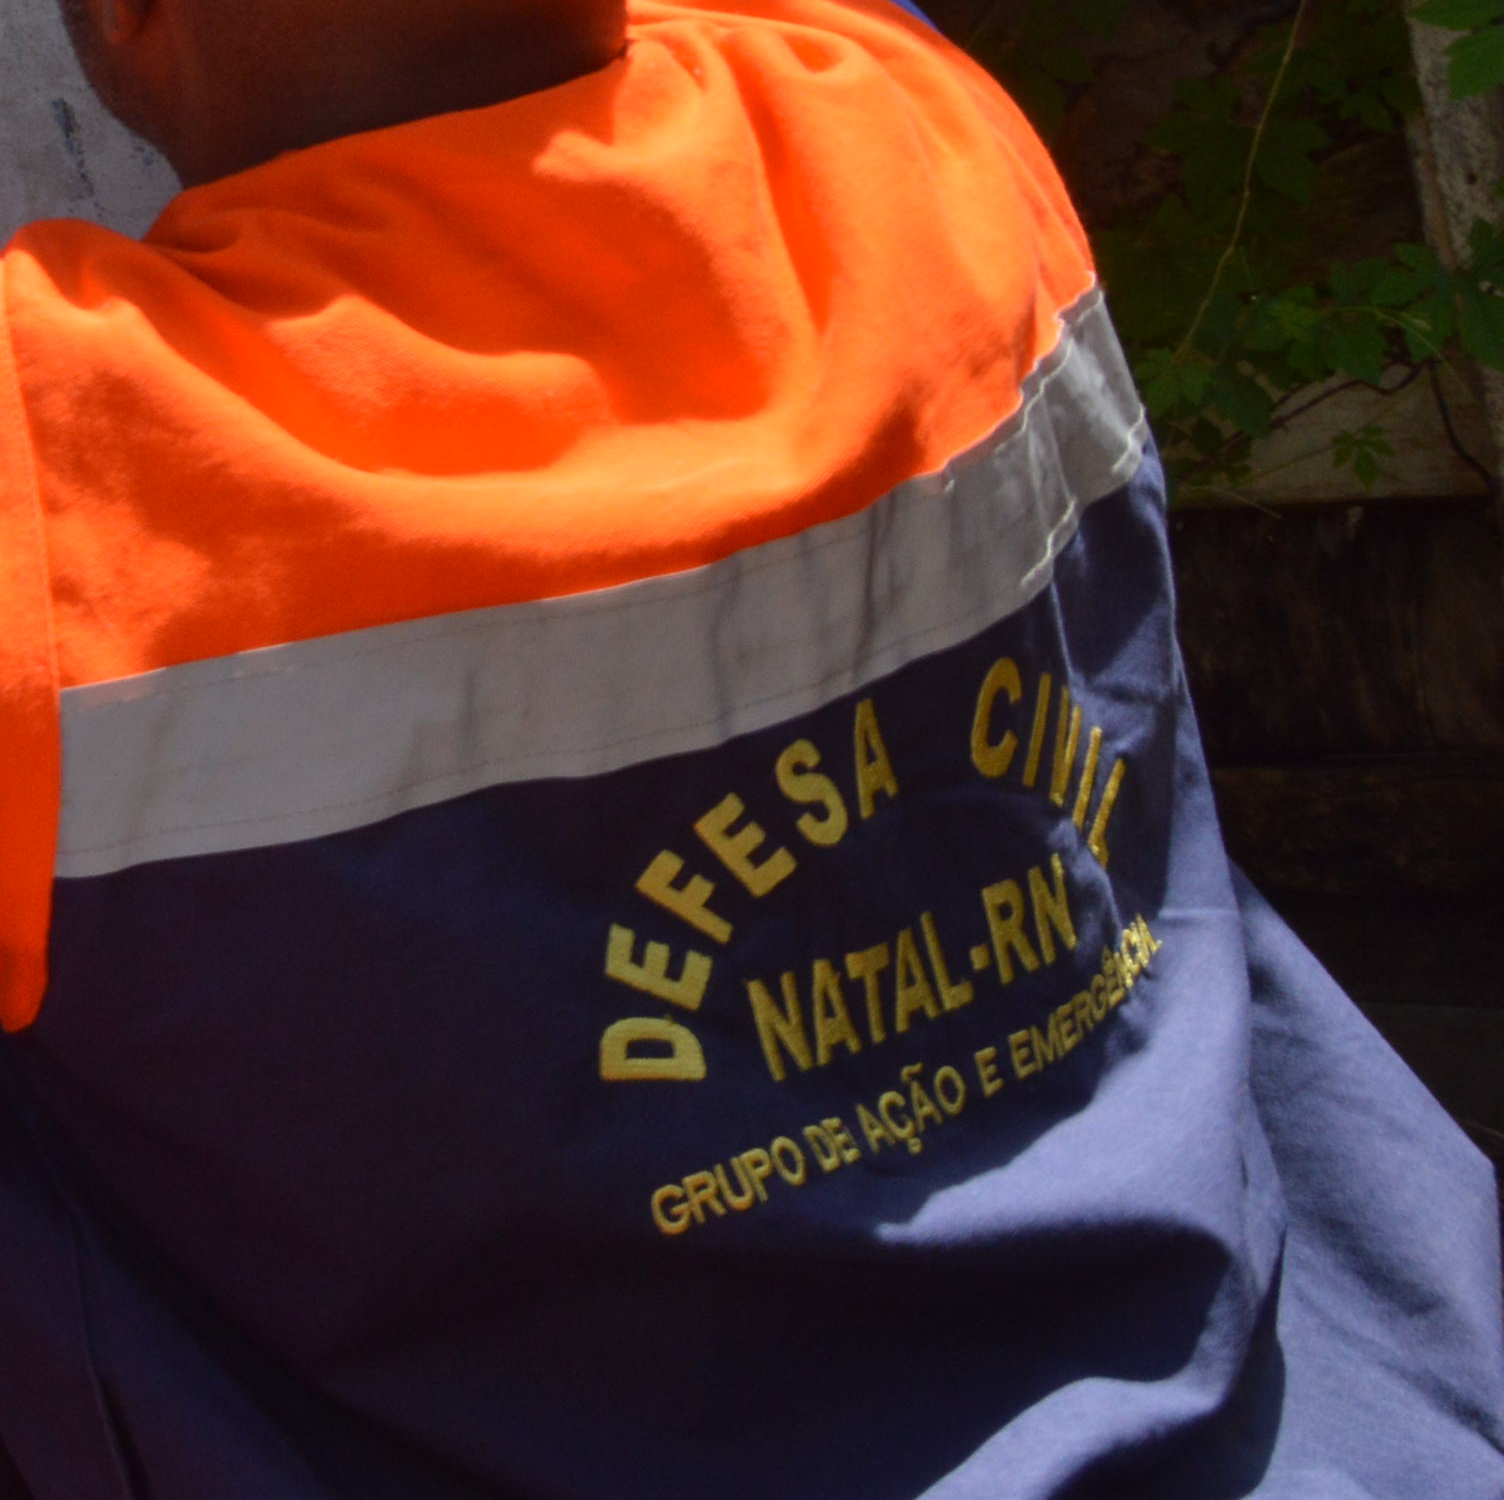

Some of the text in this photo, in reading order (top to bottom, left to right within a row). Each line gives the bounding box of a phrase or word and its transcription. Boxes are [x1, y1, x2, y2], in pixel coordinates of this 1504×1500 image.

[598, 656, 1125, 1082] DEFESA CIVIL
[744, 852, 1078, 1083] NATAL-RN
[649, 1134, 807, 1236] GRUPO
[803, 1116, 864, 1173] DE
[854, 1062, 967, 1155] AÇÃO
[973, 1045, 1004, 1100] E
